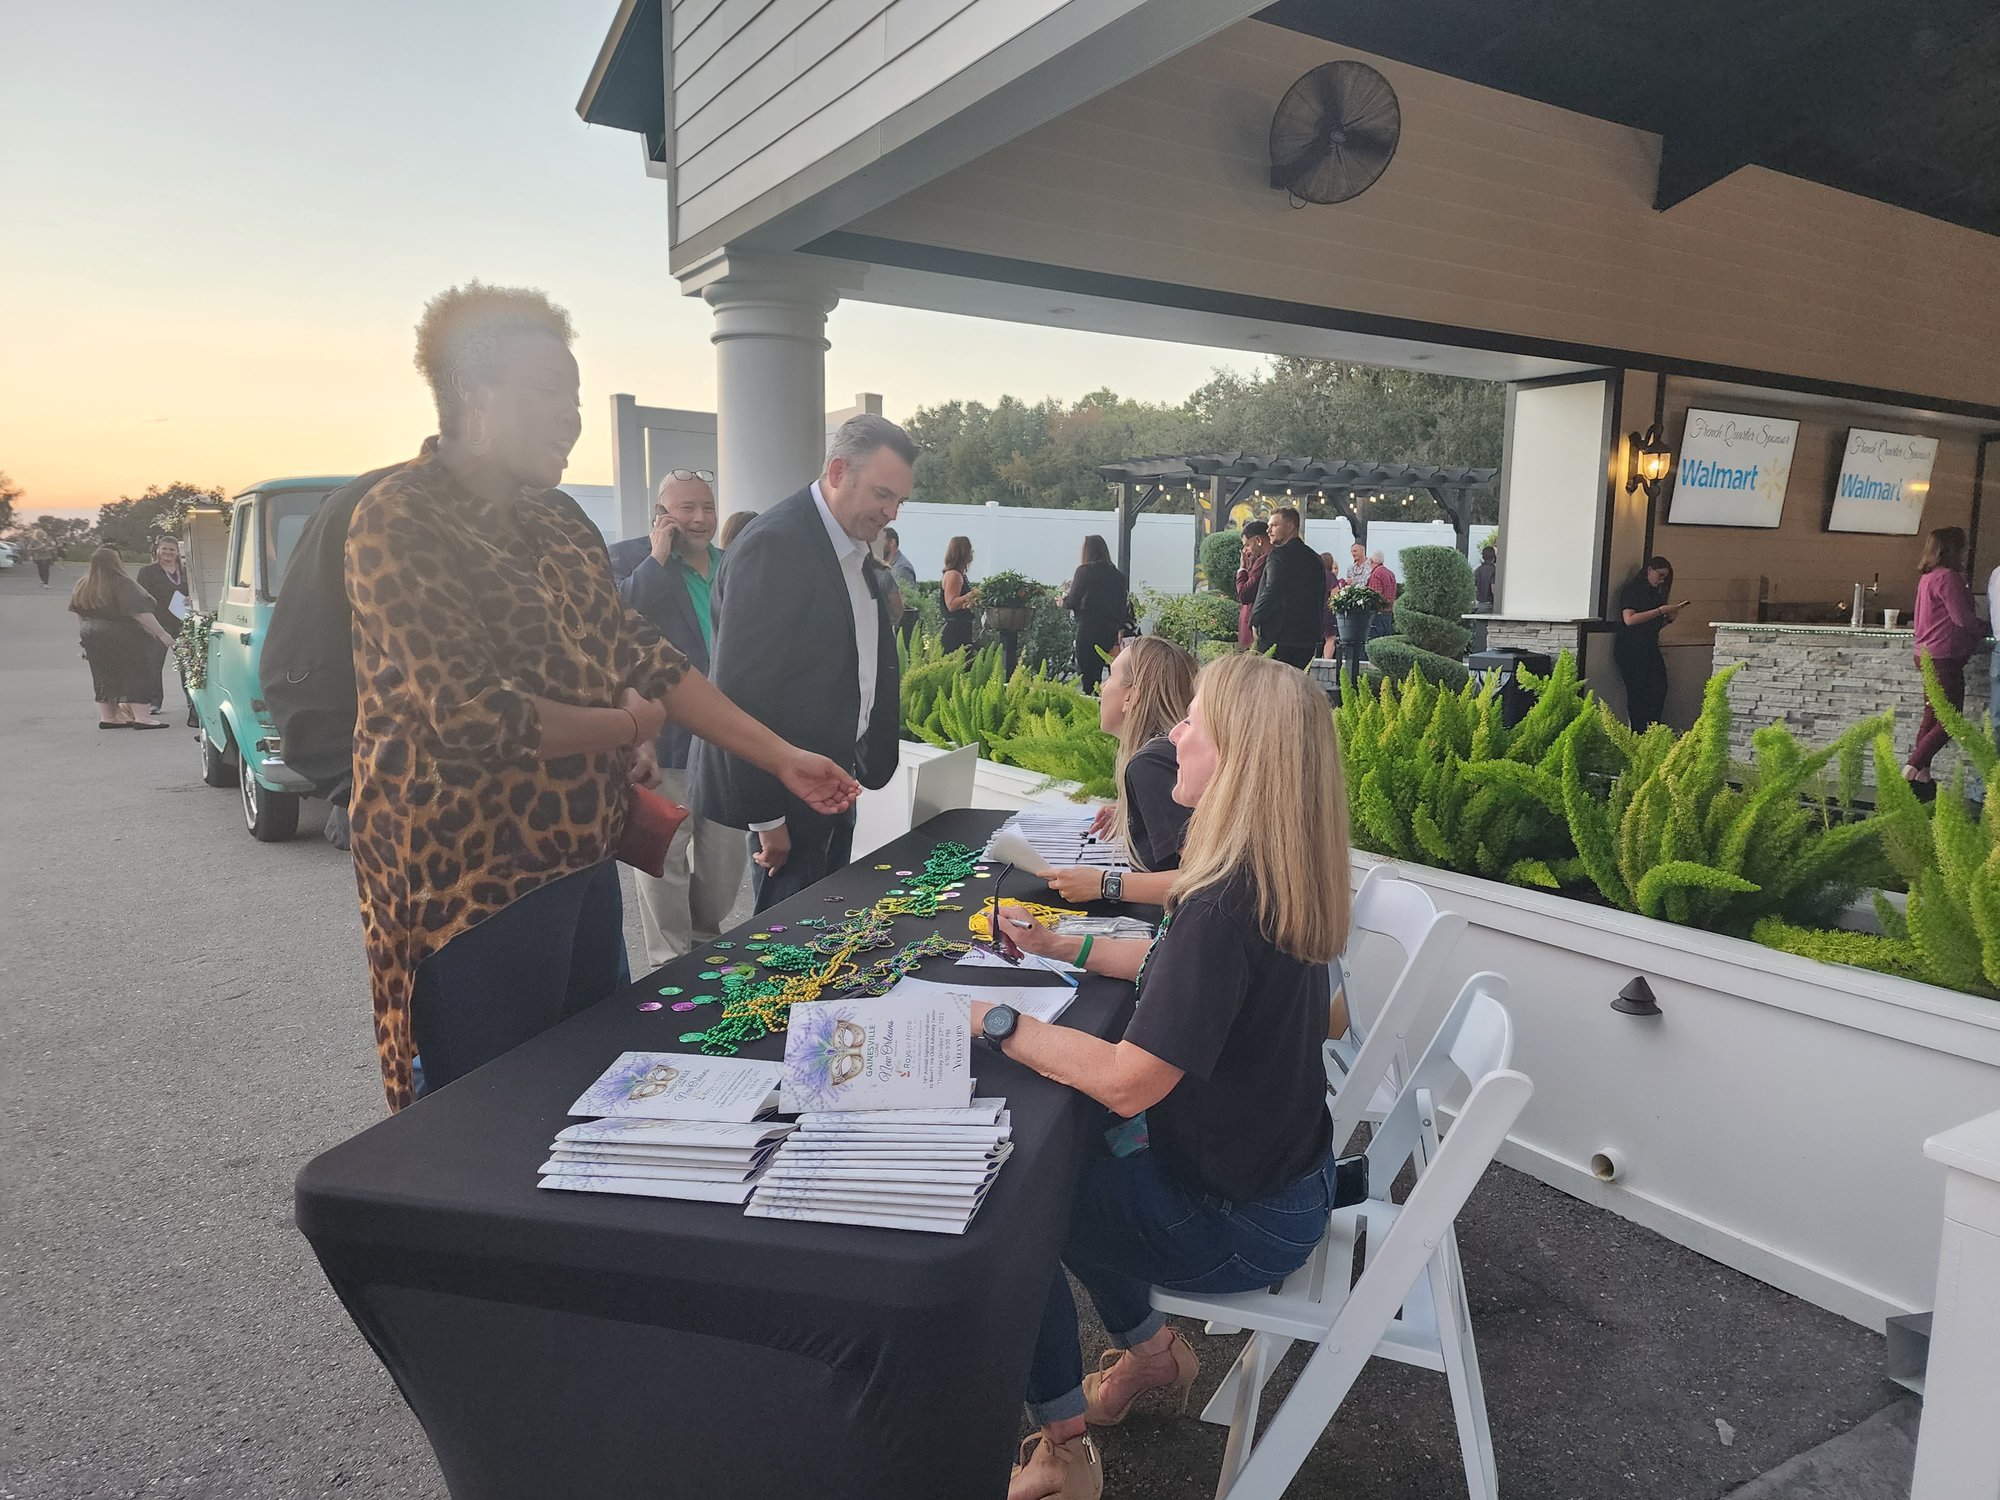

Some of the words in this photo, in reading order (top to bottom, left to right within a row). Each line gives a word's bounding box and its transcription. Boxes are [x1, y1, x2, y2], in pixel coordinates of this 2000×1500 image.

[1690, 417, 1723, 438] French
[1724, 421, 1755, 447] Quarter
[1681, 458, 1759, 491] Walmart
[1841, 473, 1904, 502] Walmart
[880, 1020, 894, 1056] Orleans
[905, 1020, 913, 1041] Hope
[865, 1024, 876, 1078] GAINESVILLE
[903, 1049, 912, 1069] Rays
[878, 1055, 893, 1083] New
